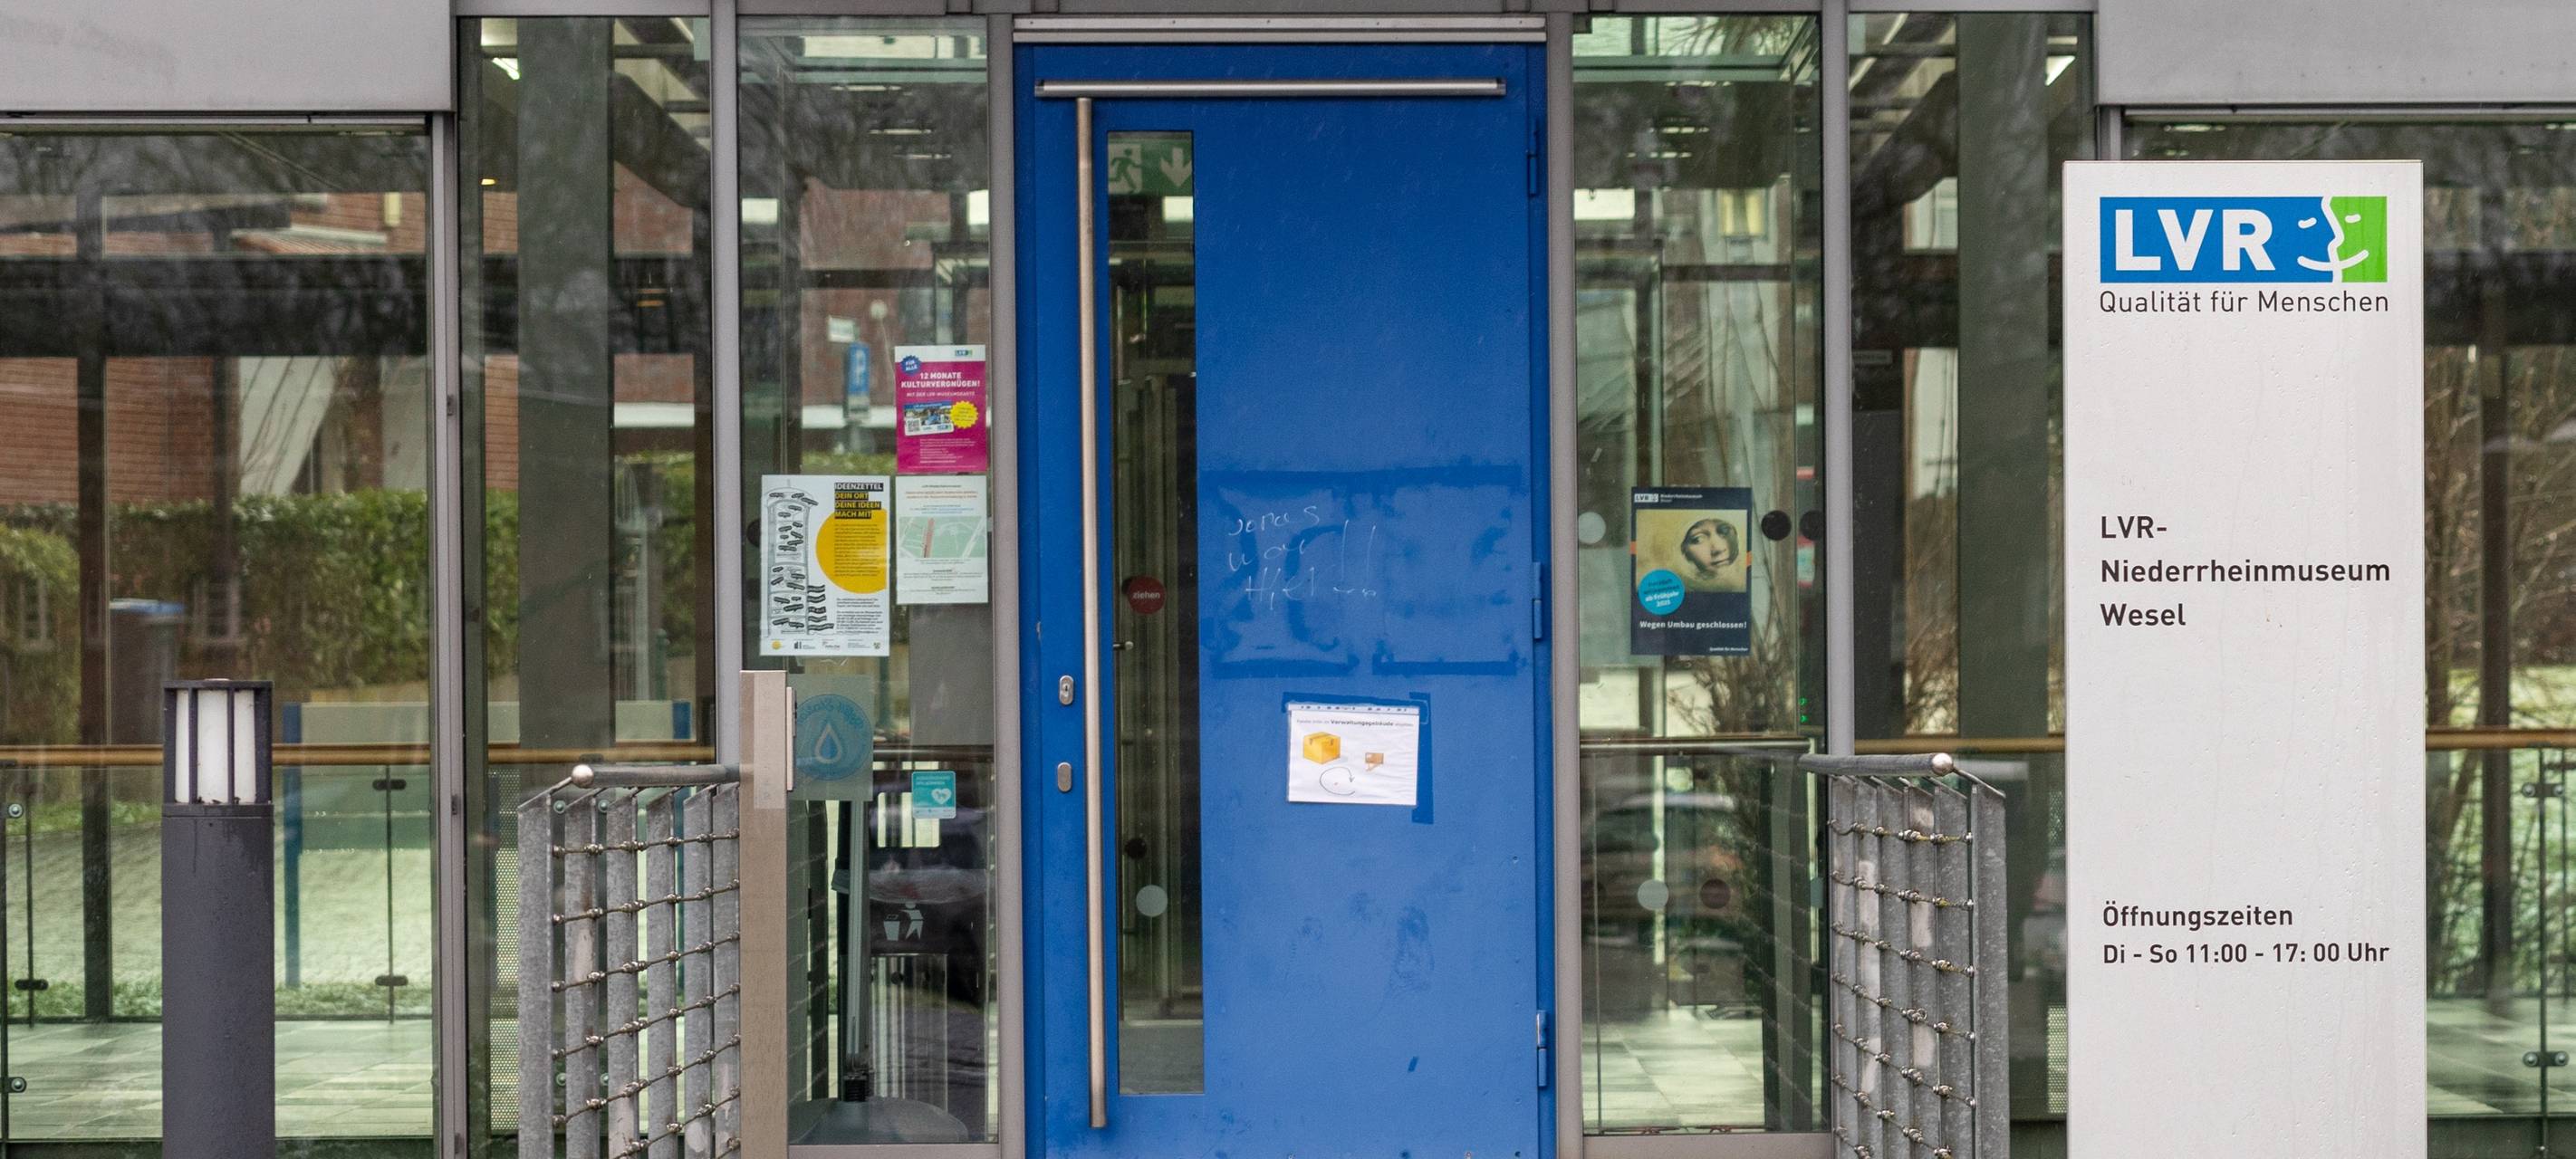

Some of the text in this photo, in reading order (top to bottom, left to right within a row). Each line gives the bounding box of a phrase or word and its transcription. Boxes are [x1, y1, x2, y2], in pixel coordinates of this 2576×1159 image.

[2115, 209, 2276, 272] LVR
[2100, 291, 2389, 313] Qualität für Menschen
[929, 371, 962, 379] MONATE
[901, 379, 981, 388] KULTURVERGNÜGEN!
[834, 483, 884, 491] IDEENZETTEL
[835, 492, 869, 500] DEIN ORT
[835, 501, 881, 509] DEINE IDEEN
[2100, 515, 2167, 539] LVR-
[2100, 559, 2390, 582] Niederrheinmuseum
[1132, 591, 1160, 599] ziehen
[2100, 603, 2187, 627] Wesel
[1639, 620, 1747, 630] Wegen Umbau geschlossen!
[1331, 719, 1394, 727] Verwaltungsgebäude
[2102, 901, 2293, 932] Öffnungszeiten
[2103, 943, 2126, 963] Di
[2149, 943, 2177, 963] So
[2186, 943, 2247, 963] 11:00
[2348, 943, 2390, 963] Uhr
